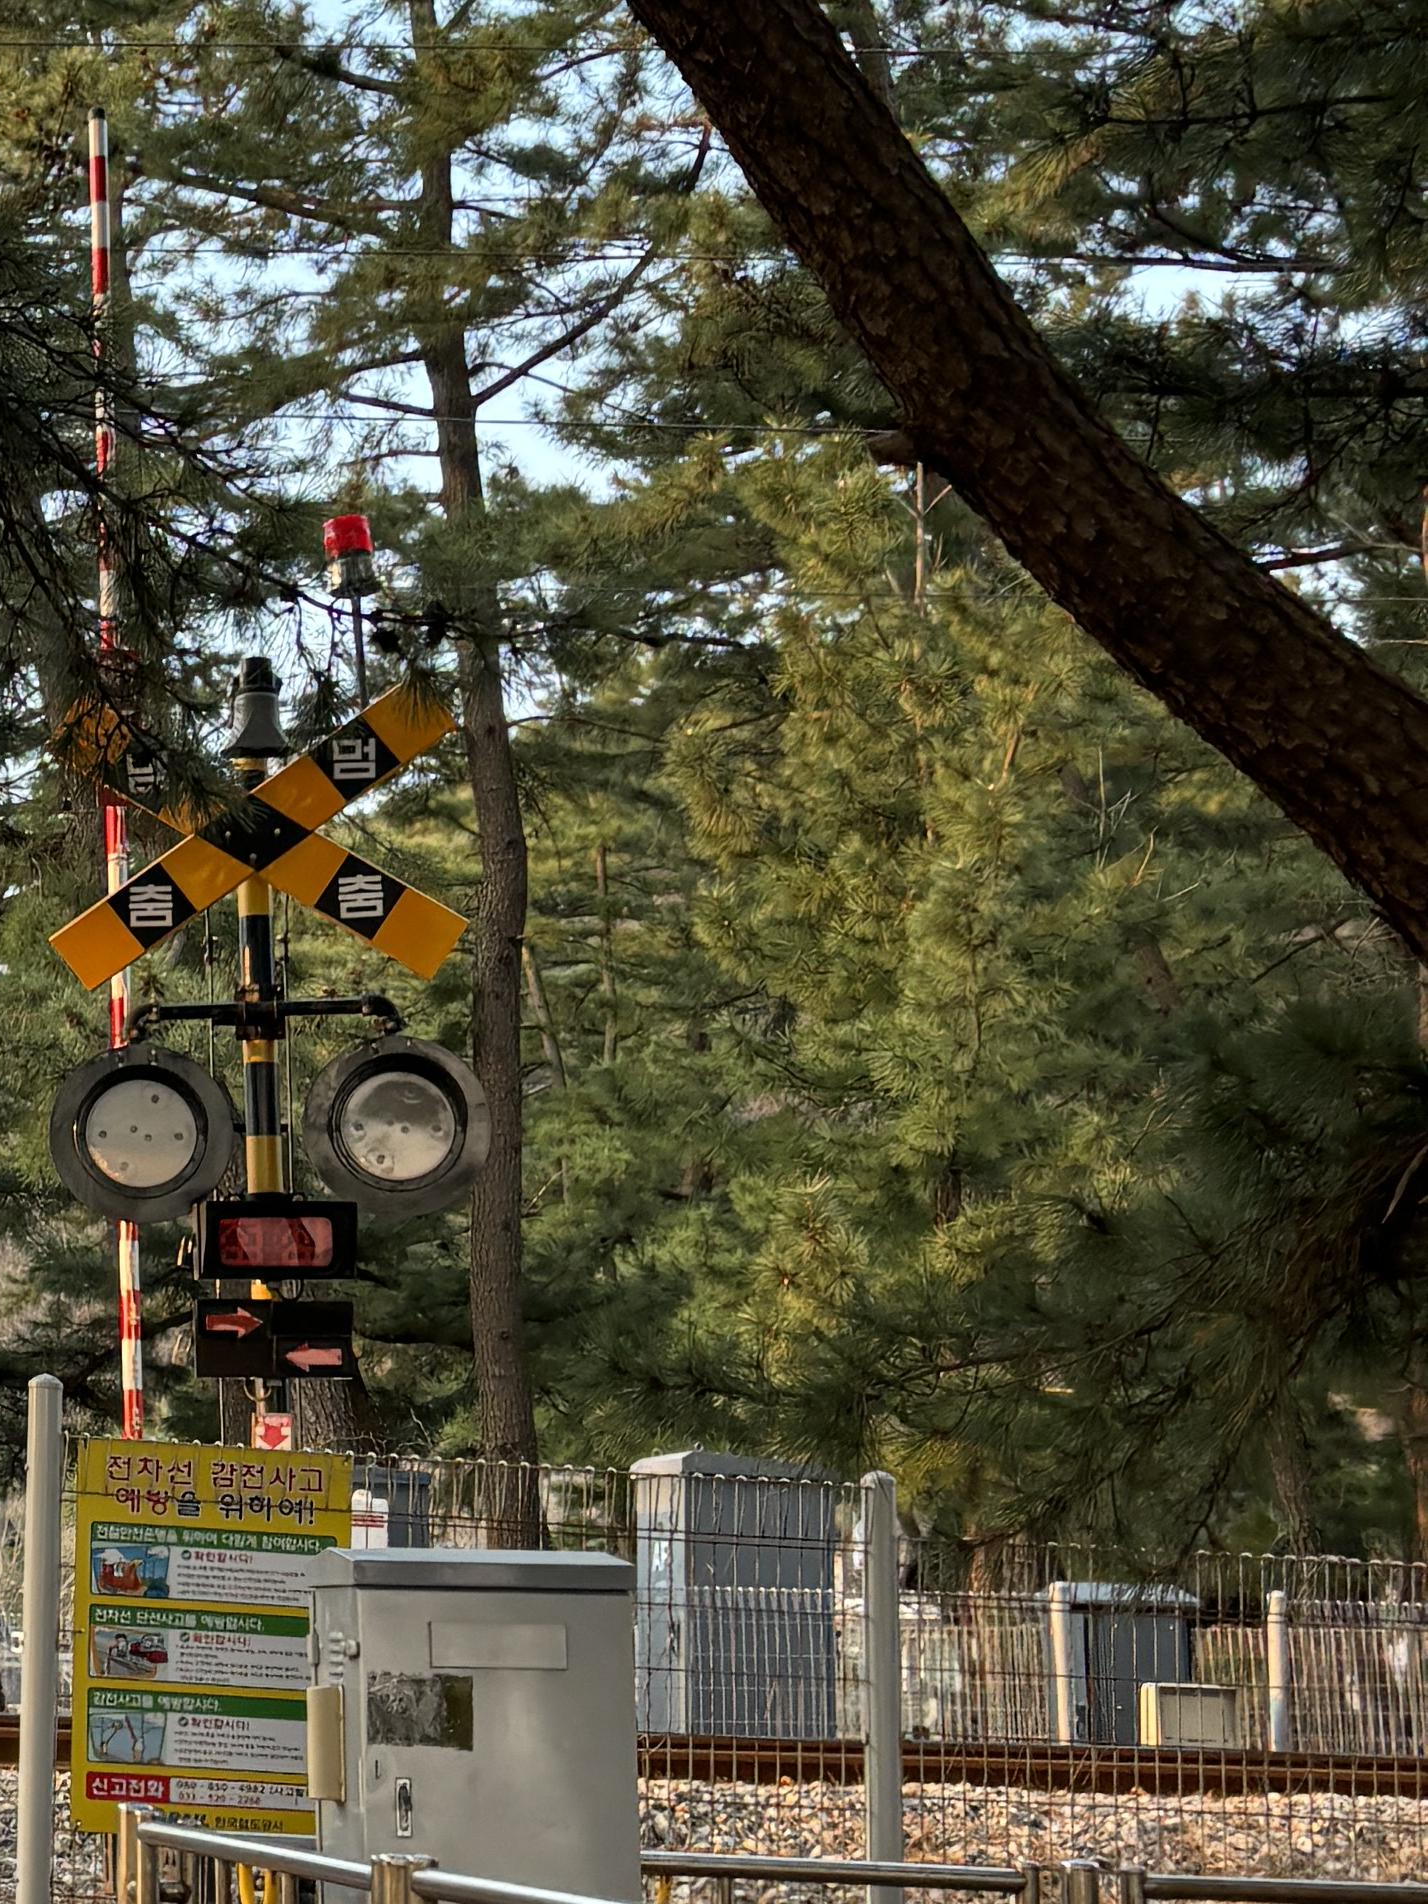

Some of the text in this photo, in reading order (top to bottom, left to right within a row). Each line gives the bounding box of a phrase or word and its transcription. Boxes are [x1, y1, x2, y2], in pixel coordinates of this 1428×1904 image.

[107, 1455, 324, 1493] 전차선 감전사고
[115, 1487, 315, 1525] 예방을 위하여!
[92, 1777, 165, 1799] 신고전화
